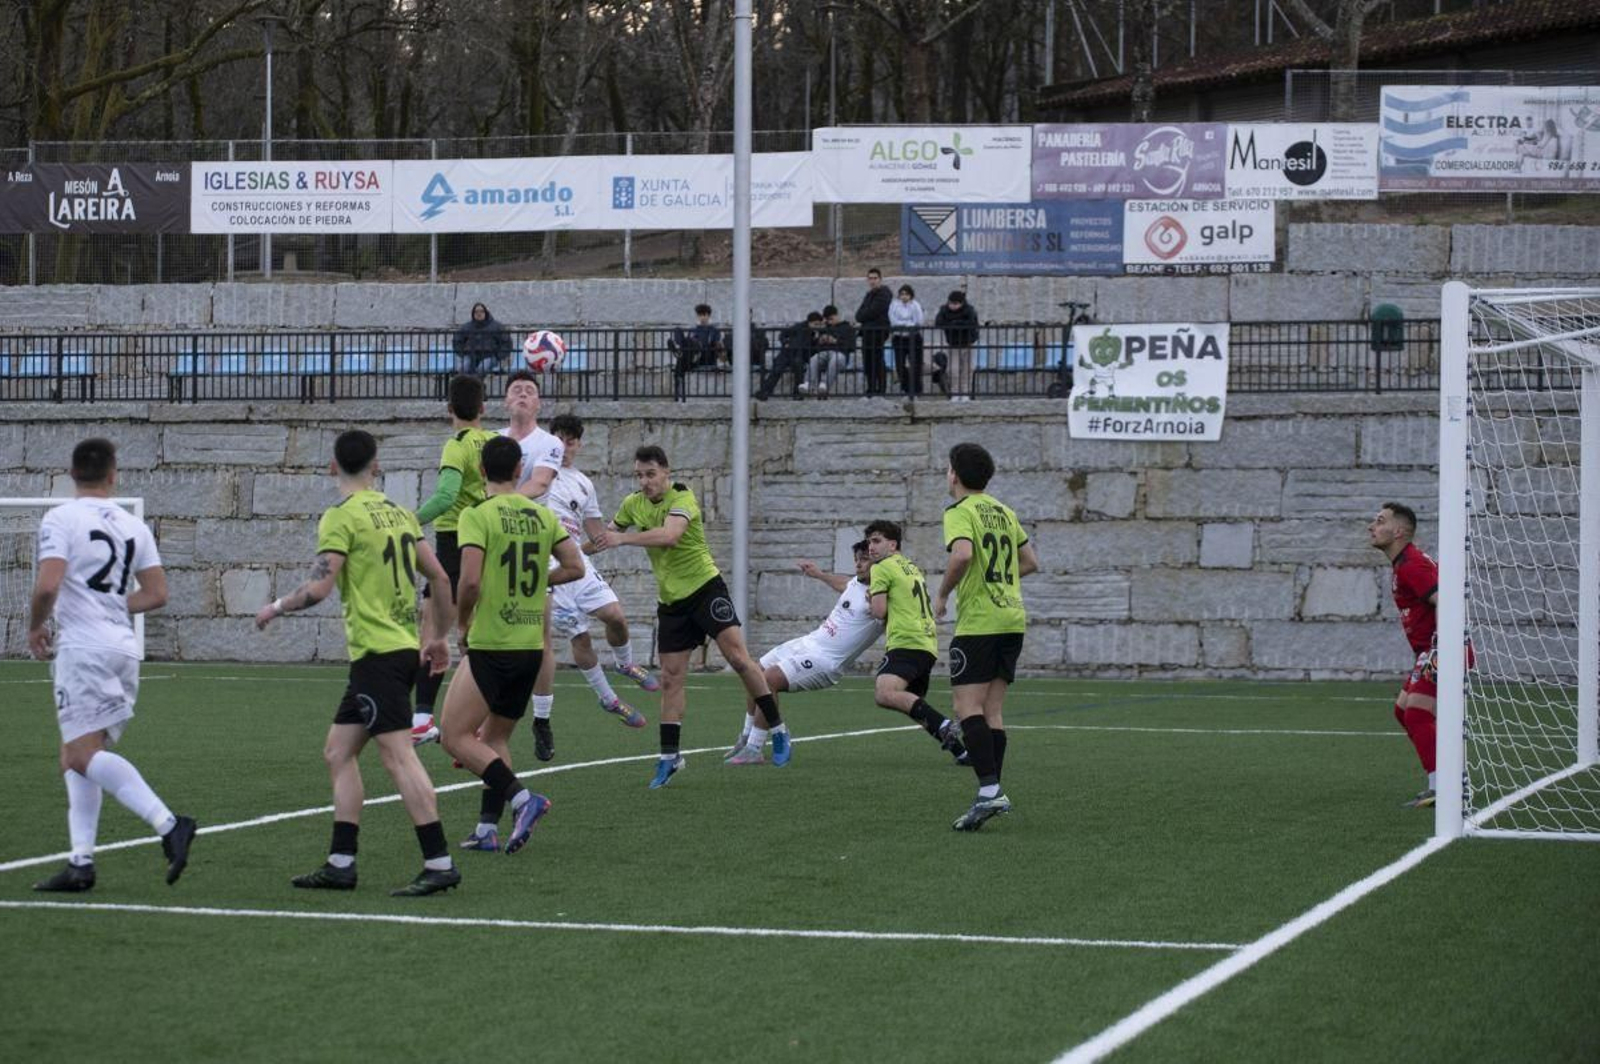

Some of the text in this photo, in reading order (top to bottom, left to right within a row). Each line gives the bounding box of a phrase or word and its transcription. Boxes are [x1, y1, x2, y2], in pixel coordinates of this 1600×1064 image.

[1446, 116, 1521, 129] ELECTRA
[869, 140, 938, 161] ALGO
[1133, 141, 1170, 171] Santa
[1230, 128, 1317, 170] Mantesil
[1435, 160, 1520, 171] COMERCIALIZADORA
[8, 171, 33, 182] A Reza
[65, 167, 128, 197] MESÓN A
[156, 171, 180, 182] Arnoia
[204, 170, 380, 190] IGLESIAS & RUYSA
[640, 179, 690, 192] XUNTA
[464, 181, 574, 205] amando
[1192, 182, 1222, 192] ARNOIA
[211, 200, 371, 212] CONSTRUCCIONES Y REFORMAS
[639, 194, 657, 207] DE
[662, 194, 721, 207] GALICIA
[1192, 201, 1207, 212] DE
[1212, 200, 1270, 211] SERVICIO
[49, 192, 136, 229] LAREIRA
[229, 213, 352, 226] COLOCACIÓN DE PIEDRA
[554, 205, 575, 217] S.L.
[963, 208, 1047, 229] LUMBERSA
[1070, 230, 1110, 239] REFORMAS
[1200, 219, 1254, 246] galp
[963, 232, 1065, 252] MONTAJES SL
[1126, 264, 1165, 274] BEADE
[1209, 262, 1229, 273] 692
[1231, 262, 1249, 273] 601
[1252, 262, 1271, 273] 138
[1124, 327, 1223, 361] PEÑA
[1088, 417, 1205, 434] #ForzArnoia
[86, 529, 136, 596] 21
[382, 532, 417, 597] 10
[982, 532, 1014, 586] 22
[501, 541, 540, 598] 15
[801, 659, 813, 669] 9
